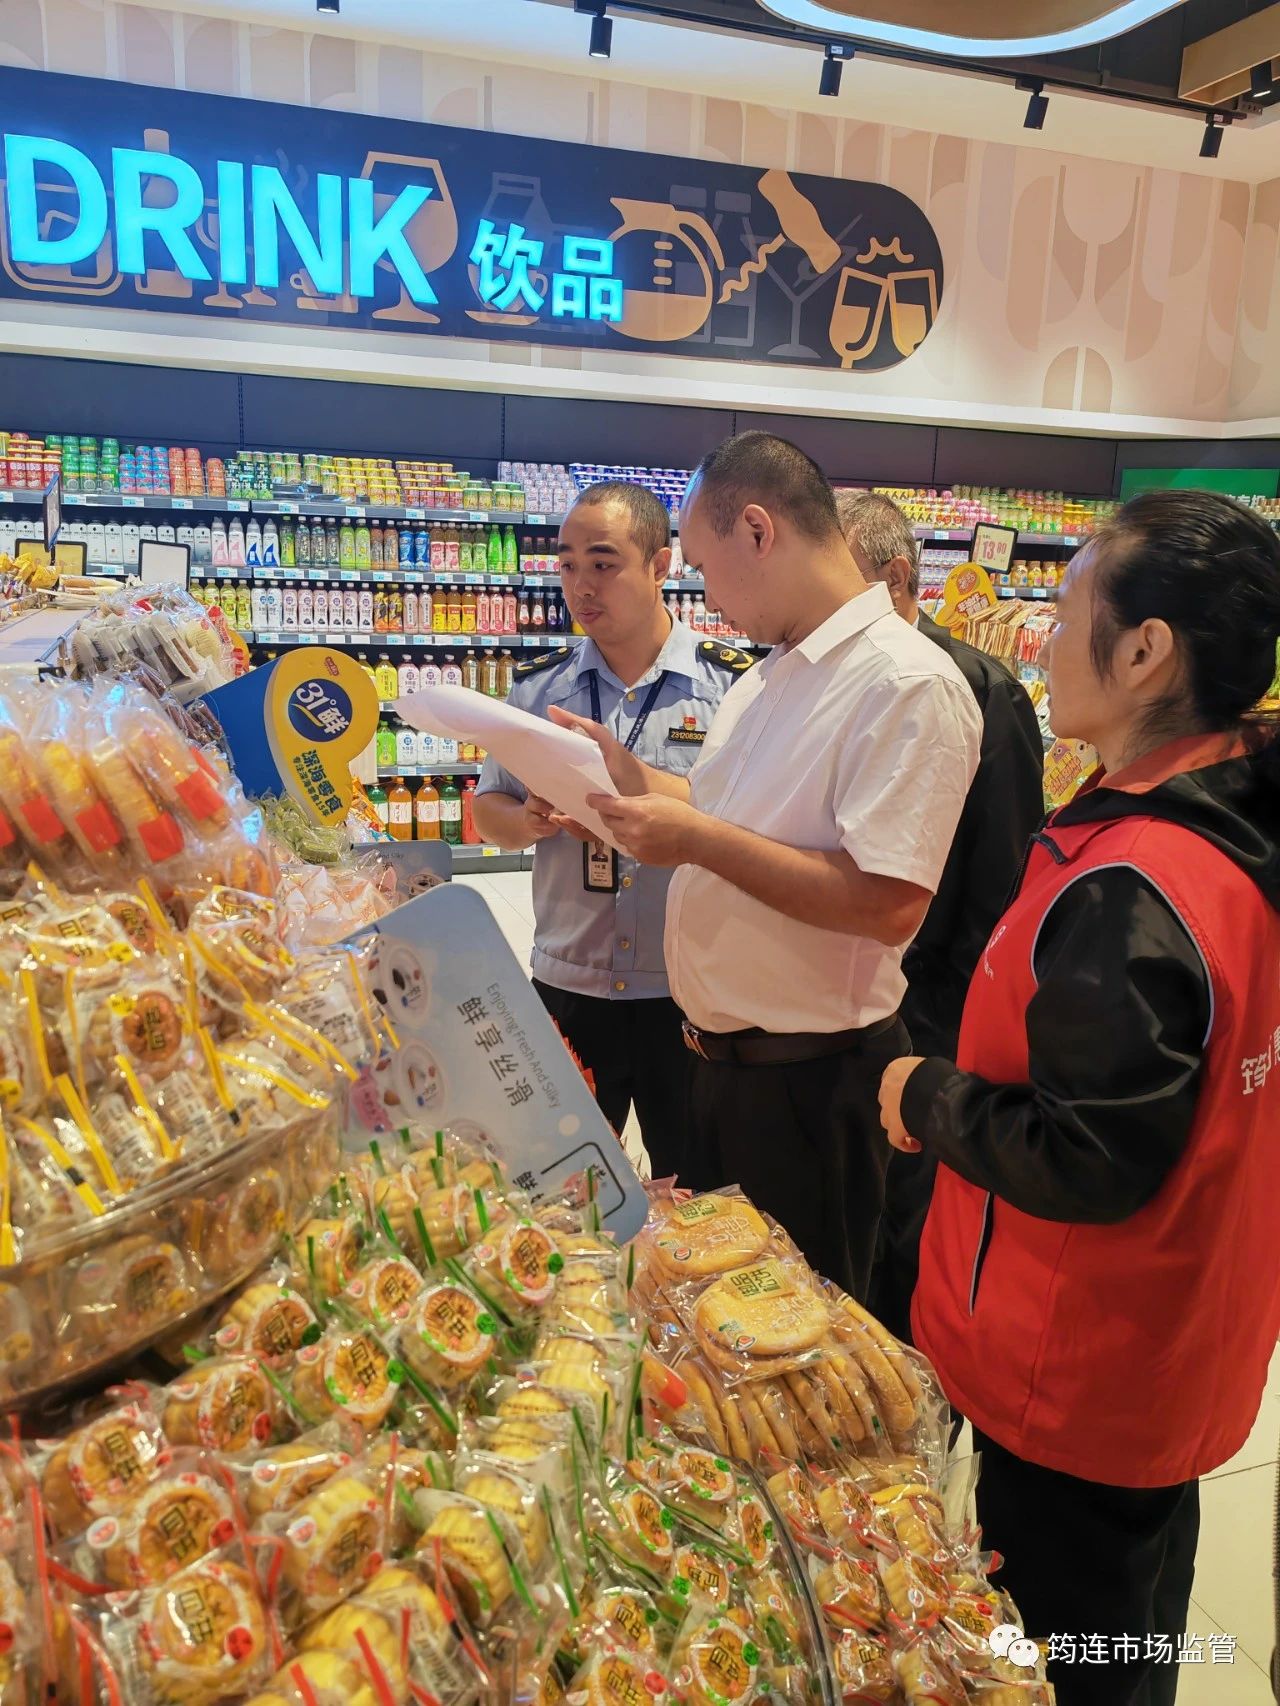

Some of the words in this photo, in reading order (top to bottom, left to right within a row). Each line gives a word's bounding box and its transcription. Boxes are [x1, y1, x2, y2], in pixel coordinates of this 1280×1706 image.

[3, 132, 440, 305] DRINK
[468, 218, 625, 323] 饮品
[301, 750, 343, 813] 深海零食
[457, 997, 534, 1106] 鲜享丝滑
[487, 982, 518, 1034] Enjoying
[514, 1030, 536, 1060] Fresh
[531, 1060, 550, 1083] And
[542, 1081, 561, 1108] Silky
